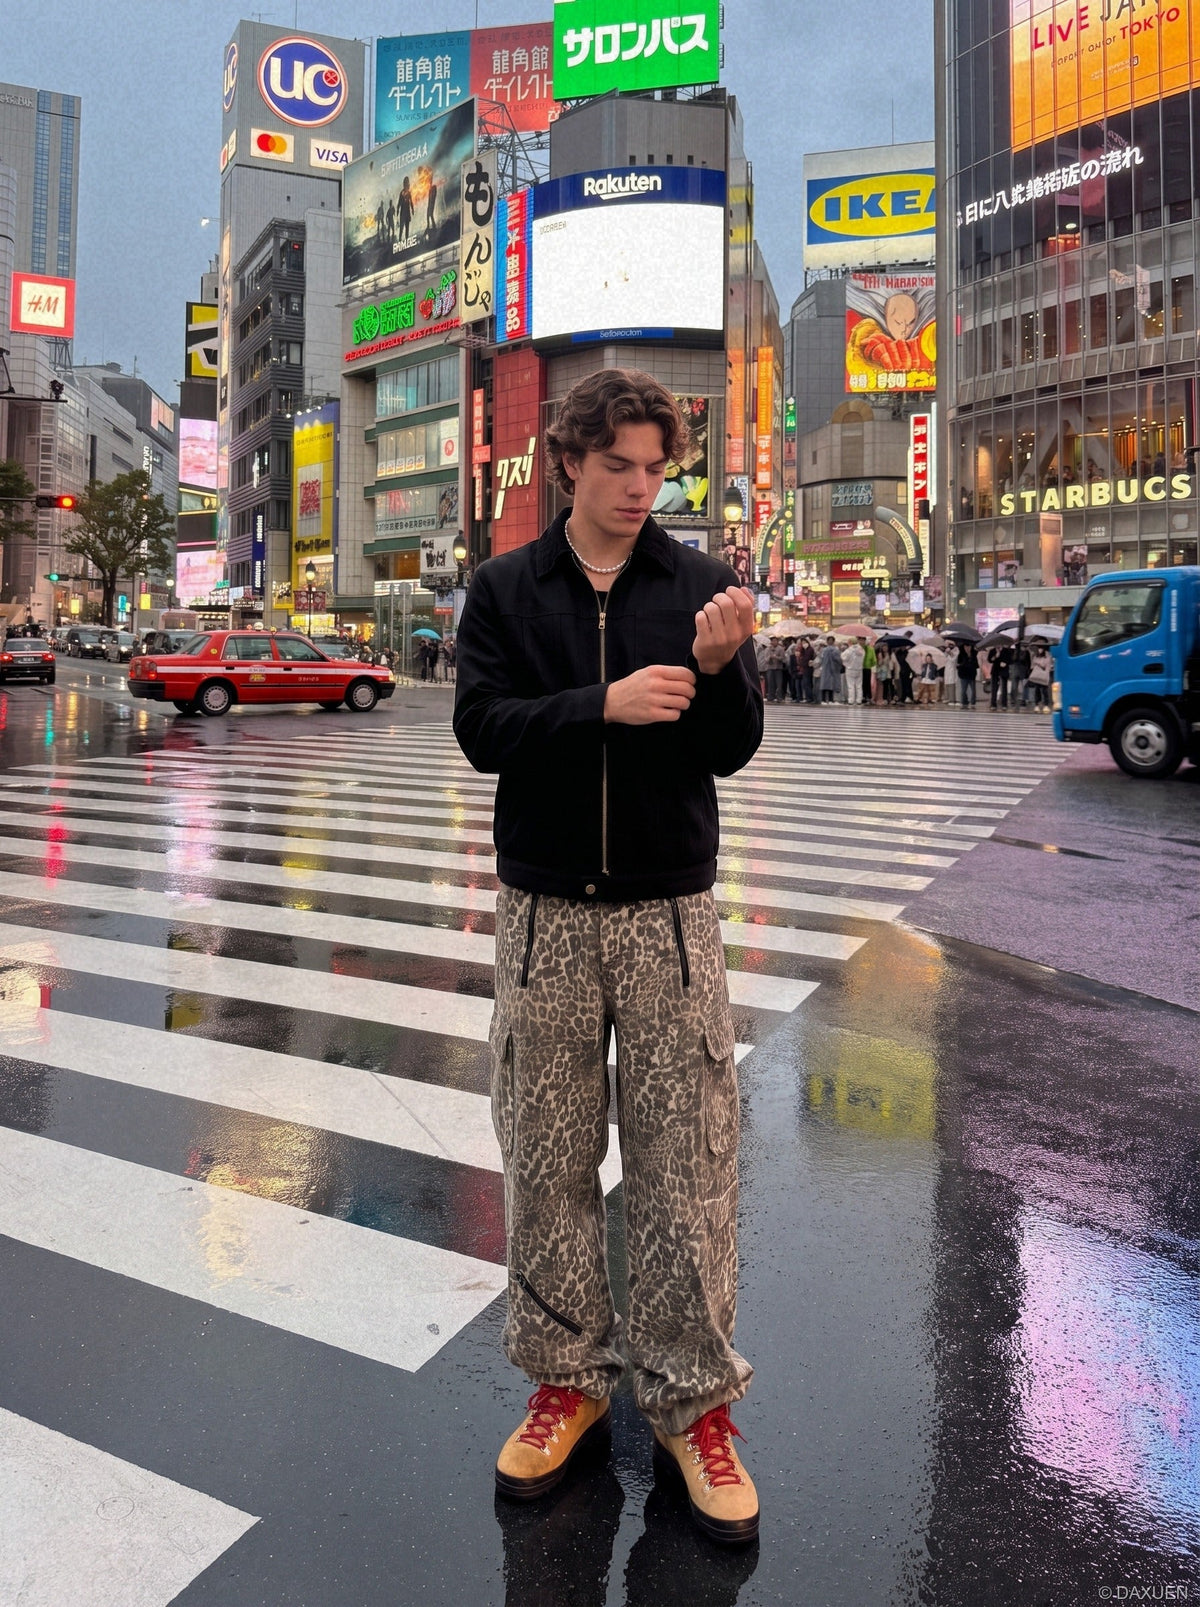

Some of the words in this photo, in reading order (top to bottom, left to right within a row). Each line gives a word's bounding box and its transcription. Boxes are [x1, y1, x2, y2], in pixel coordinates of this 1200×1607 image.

[1033, 6, 1089, 50] LIVE
[1120, 7, 1180, 40] TOKYO
[315, 147, 349, 164] VISA
[583, 172, 662, 198] Rakuten
[464, 160, 494, 312] もんじゃ
